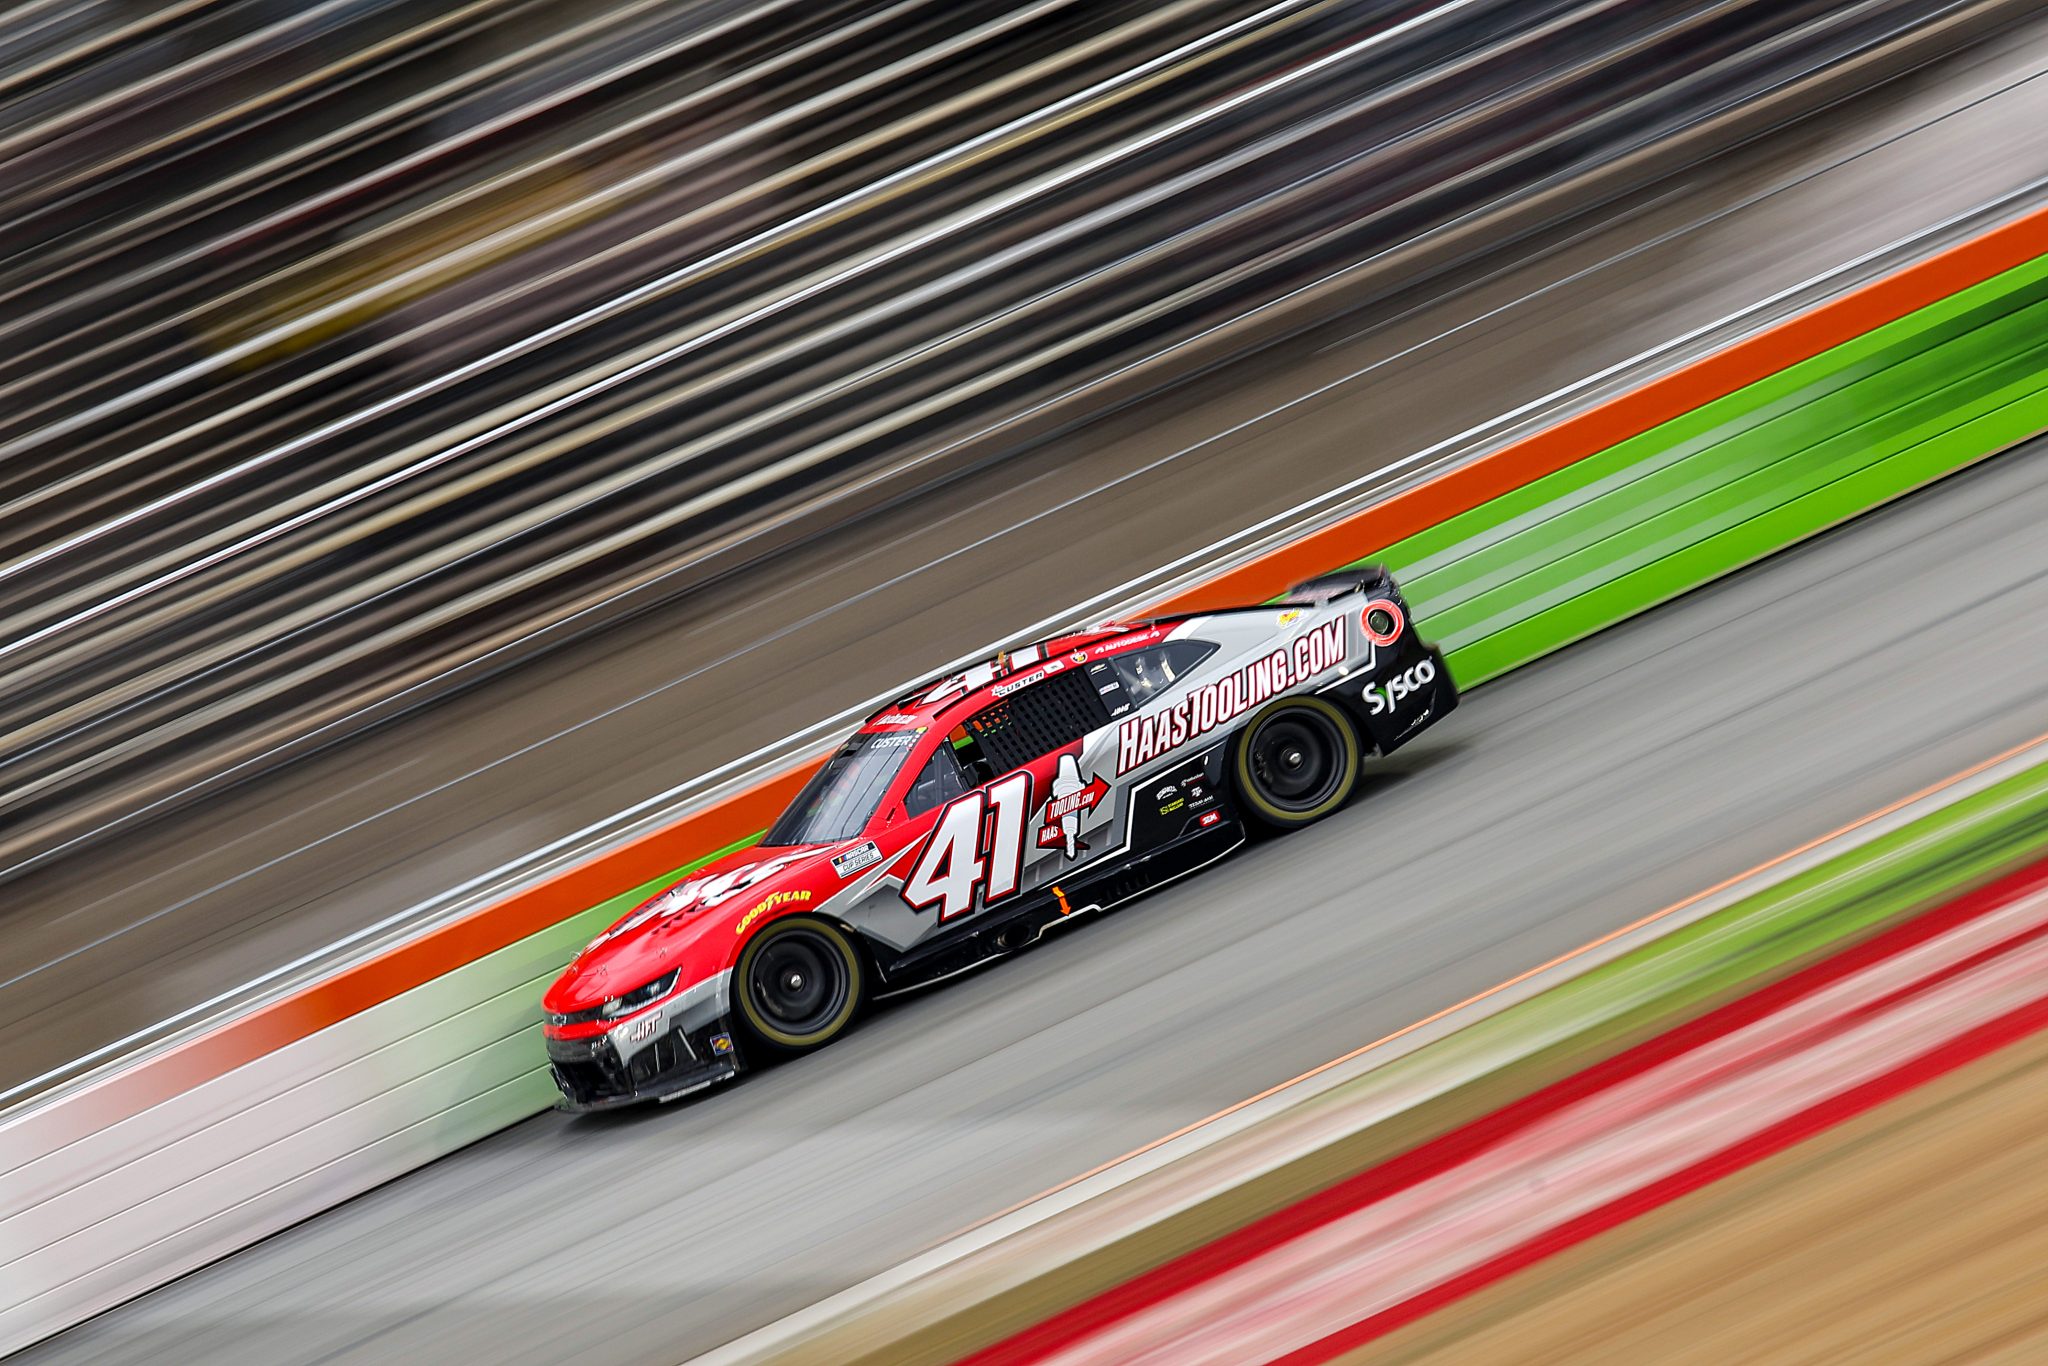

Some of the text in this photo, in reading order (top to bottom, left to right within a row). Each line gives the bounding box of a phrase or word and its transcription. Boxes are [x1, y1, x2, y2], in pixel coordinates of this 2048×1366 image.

[994, 672, 1044, 696] CUSTER
[1117, 615, 1346, 778] HAASTOOLING.COM
[870, 735, 913, 749] CUSTER
[1041, 825, 1059, 843] HAAS
[902, 772, 1030, 922] 41
[842, 852, 874, 871] CUP SERIES
[735, 890, 812, 935] GOODYEAR
